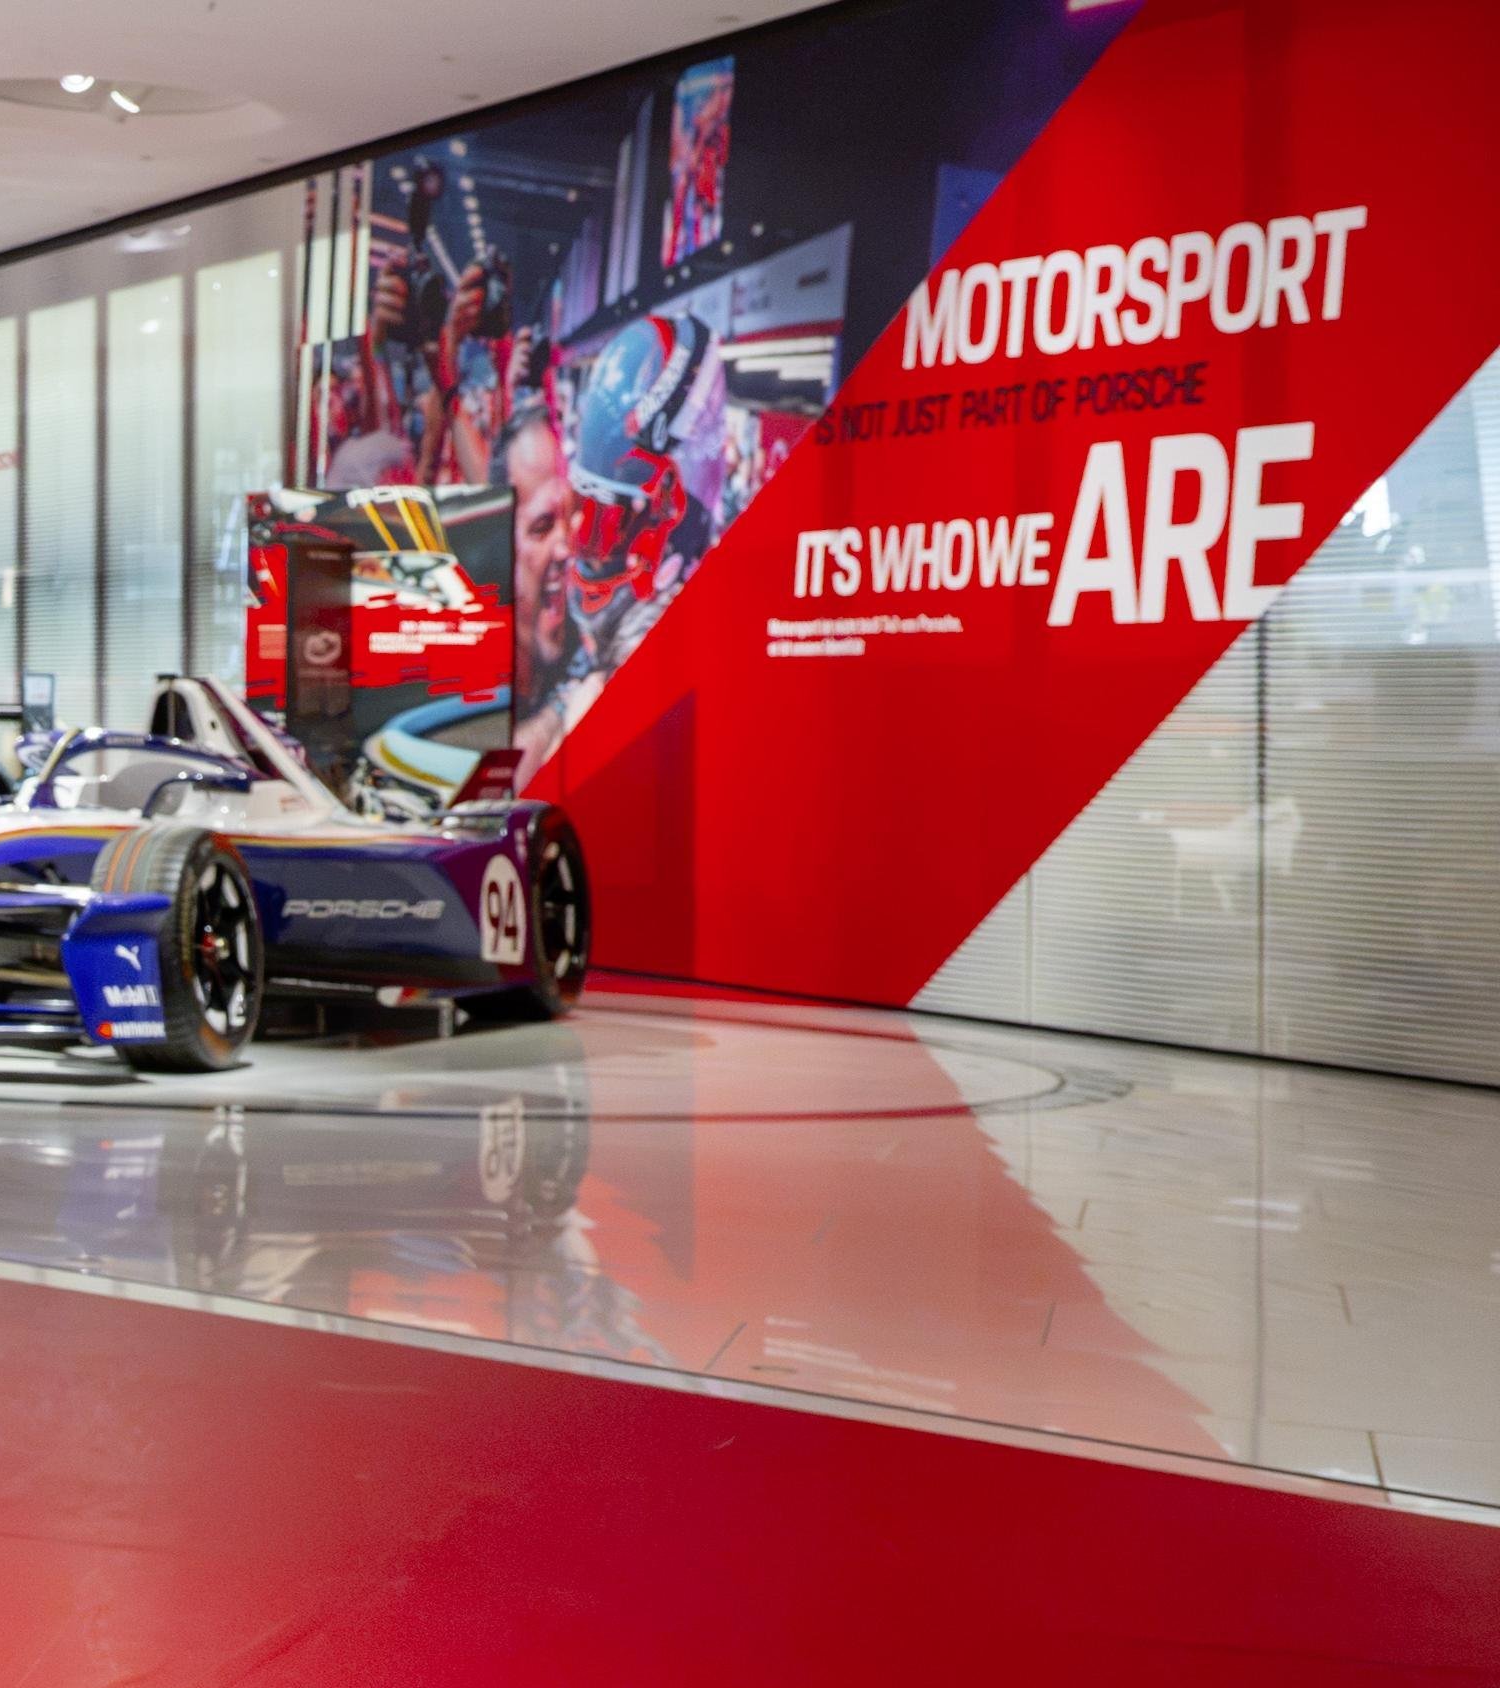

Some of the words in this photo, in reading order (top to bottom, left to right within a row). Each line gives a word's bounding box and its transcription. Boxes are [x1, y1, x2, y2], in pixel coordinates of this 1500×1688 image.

[901, 205, 1368, 370] MOTORSPORT
[815, 403, 836, 445] IS
[839, 400, 890, 444] NOT
[893, 393, 955, 438] JUST
[958, 384, 1027, 430] PART
[1030, 378, 1067, 422] OF
[1074, 360, 1211, 417] PORSCHE
[869, 518, 975, 593] WHO
[976, 512, 1055, 588] WE
[1046, 421, 1315, 628] ARE
[281, 899, 445, 919] PORSCHE
[487, 880, 518, 952] 94
